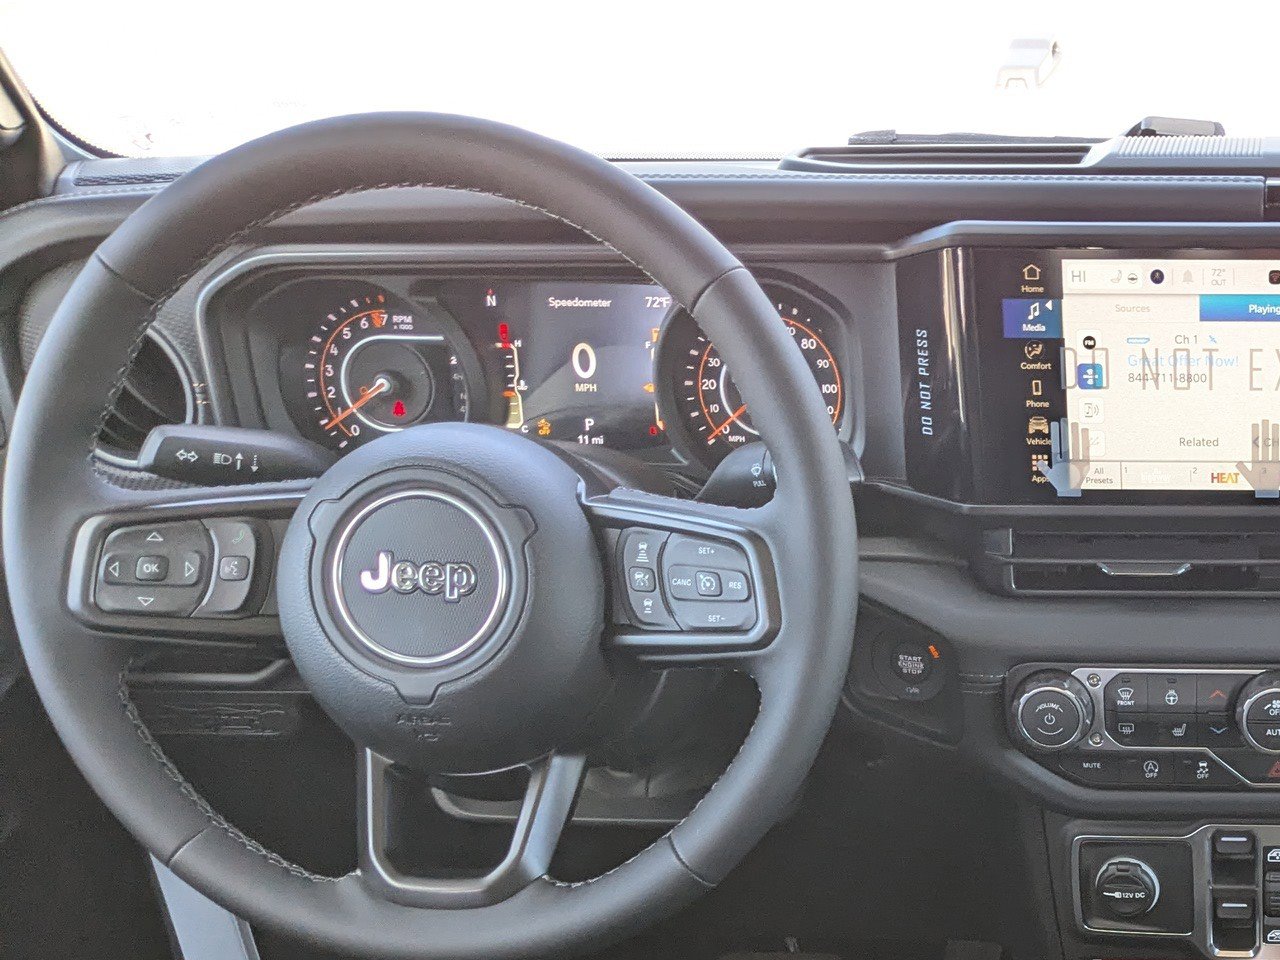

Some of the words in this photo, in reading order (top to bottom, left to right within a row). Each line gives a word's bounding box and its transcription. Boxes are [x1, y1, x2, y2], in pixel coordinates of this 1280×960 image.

[1021, 285, 1045, 293] Home
[486, 295, 497, 307] N
[548, 297, 612, 309] Speedometer
[1115, 304, 1151, 313] Sources
[360, 317, 369, 329] 6
[392, 315, 413, 323] RPM
[1022, 323, 1046, 332] Media
[342, 327, 352, 340] 5
[801, 338, 817, 350] 80
[1174, 335, 1190, 344] Ch
[330, 343, 339, 356] 4
[916, 329, 930, 376] PRESS
[572, 342, 597, 379] 0
[707, 357, 721, 368] 30
[816, 359, 829, 369] 90
[1127, 354, 1164, 367] Great
[324, 364, 334, 377] 3
[1020, 362, 1052, 370] Comfort
[1141, 347, 1220, 391] NOT
[575, 383, 597, 392] MPH
[702, 379, 717, 390] 20
[822, 384, 838, 394] 100
[327, 386, 337, 399] 2
[919, 381, 932, 410] NOT
[709, 404, 720, 413] 10
[1025, 400, 1050, 408] Phone
[584, 418, 595, 431] P
[921, 416, 933, 436] DO
[350, 425, 361, 436] 0
[577, 435, 589, 445] 11
[591, 435, 604, 445] mi
[728, 435, 746, 443] MPH
[1179, 437, 1219, 447] Related
[1093, 467, 1104, 475] All
[1031, 475, 1050, 484] App
[1085, 476, 1114, 485] Presets
[1210, 472, 1240, 484] HEAT
[698, 546, 715, 555] SET+
[143, 563, 160, 573] OK
[360, 551, 478, 602] Jeep
[672, 578, 692, 586] CANC
[728, 581, 742, 589] RES
[899, 654, 922, 662] START
